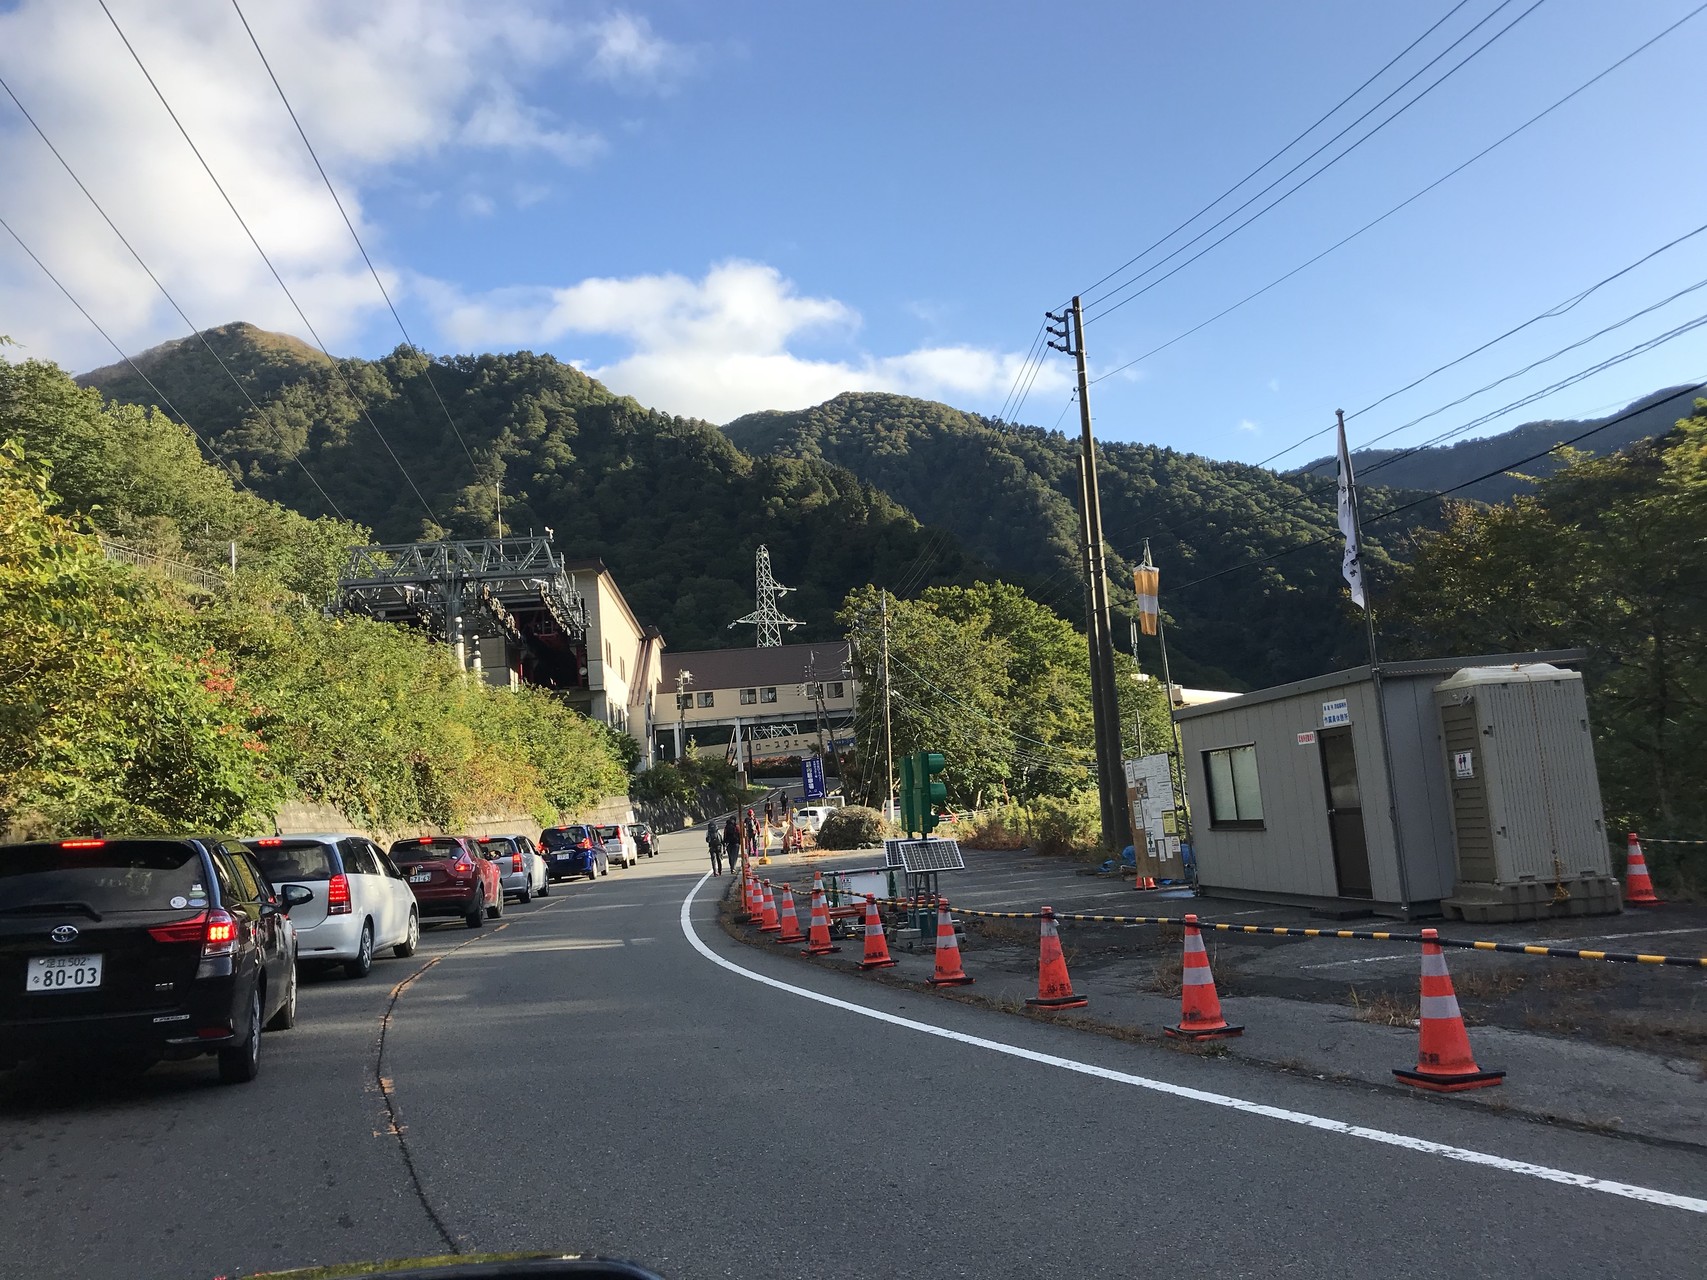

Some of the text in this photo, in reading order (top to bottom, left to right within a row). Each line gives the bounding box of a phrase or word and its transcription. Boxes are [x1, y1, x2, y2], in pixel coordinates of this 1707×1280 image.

[46, 957, 86, 968] 足立 502
[43, 967, 97, 987] 80-03
